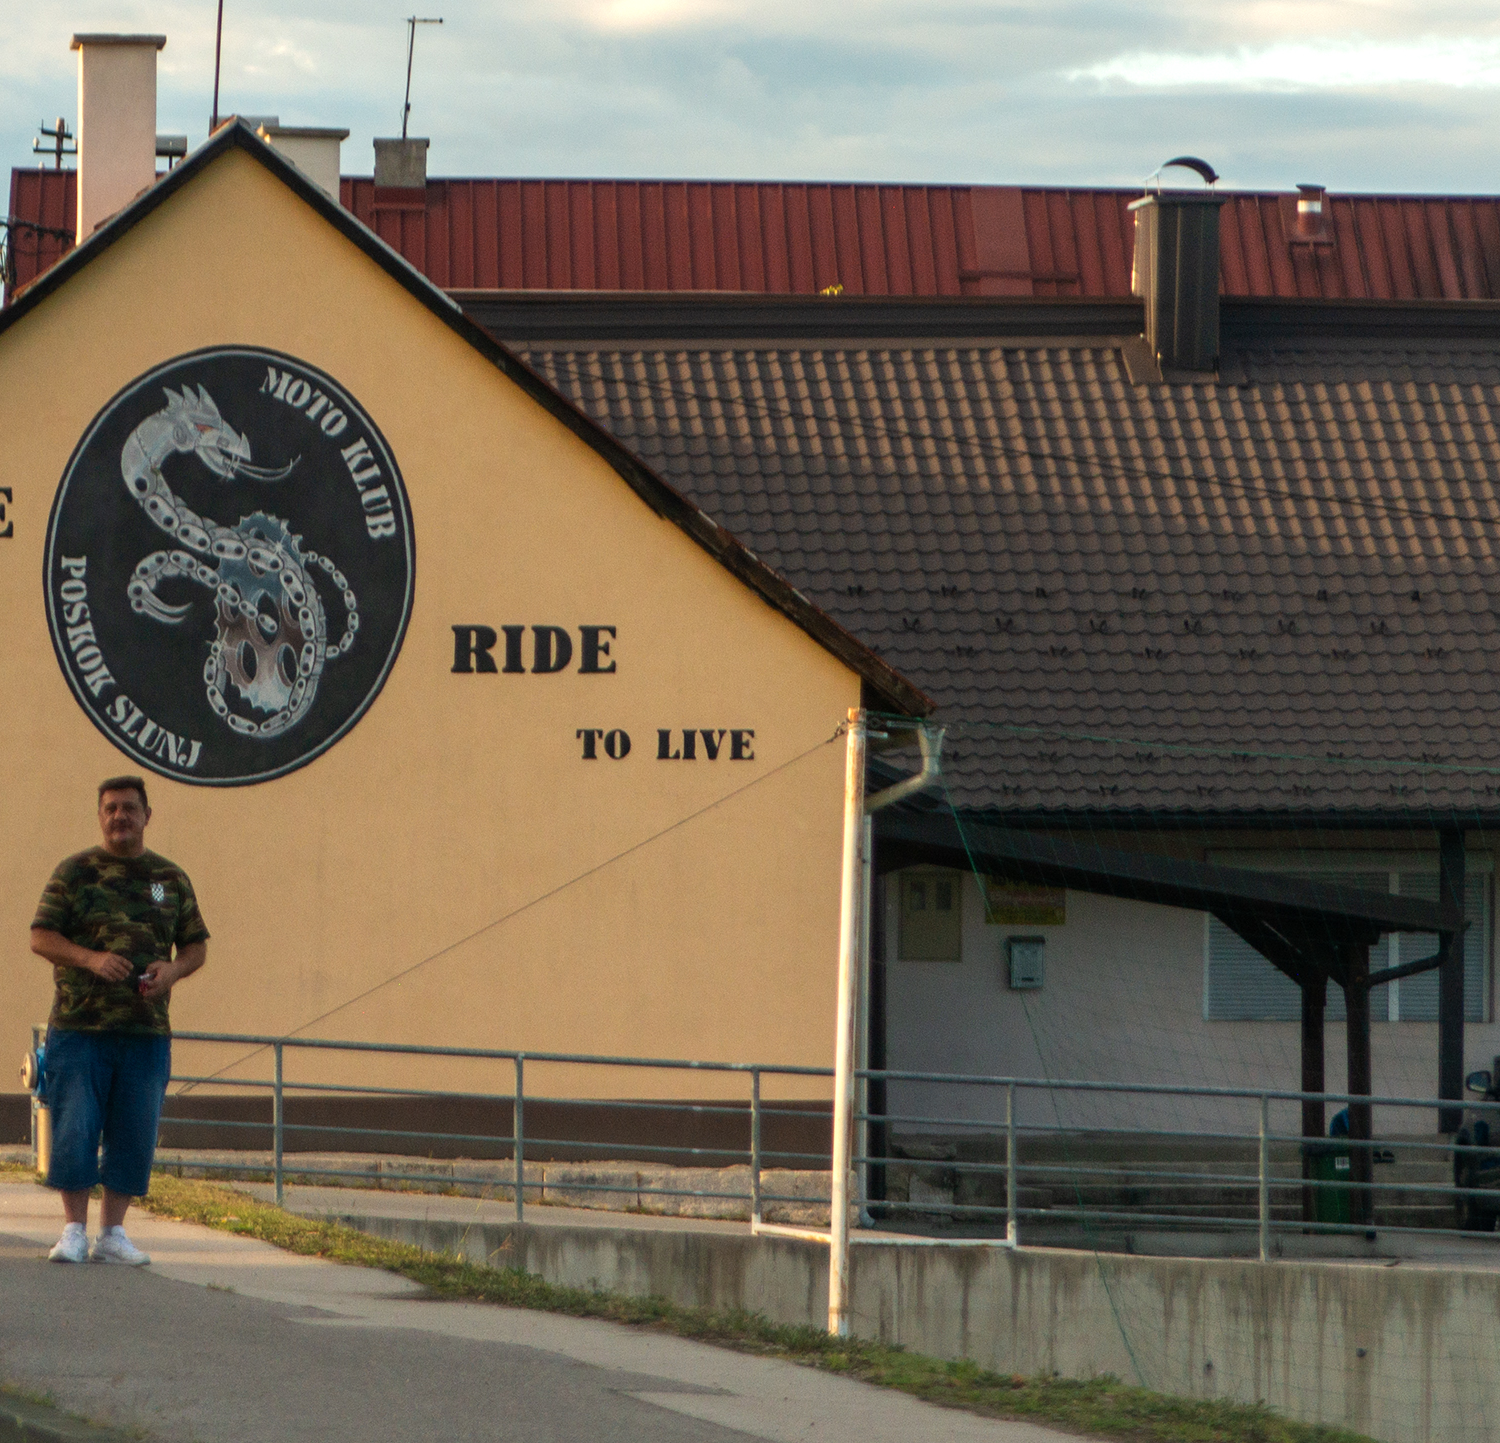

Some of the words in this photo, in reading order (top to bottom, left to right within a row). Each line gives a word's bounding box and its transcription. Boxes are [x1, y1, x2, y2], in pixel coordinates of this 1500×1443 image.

[259, 365, 348, 437] MOTO
[340, 437, 397, 540] KLUB
[60, 554, 118, 698] POSKOK
[104, 694, 203, 769] SLUNJ
[450, 624, 617, 674] RIDE
[576, 728, 632, 760] TO
[656, 728, 755, 761] LIVE
